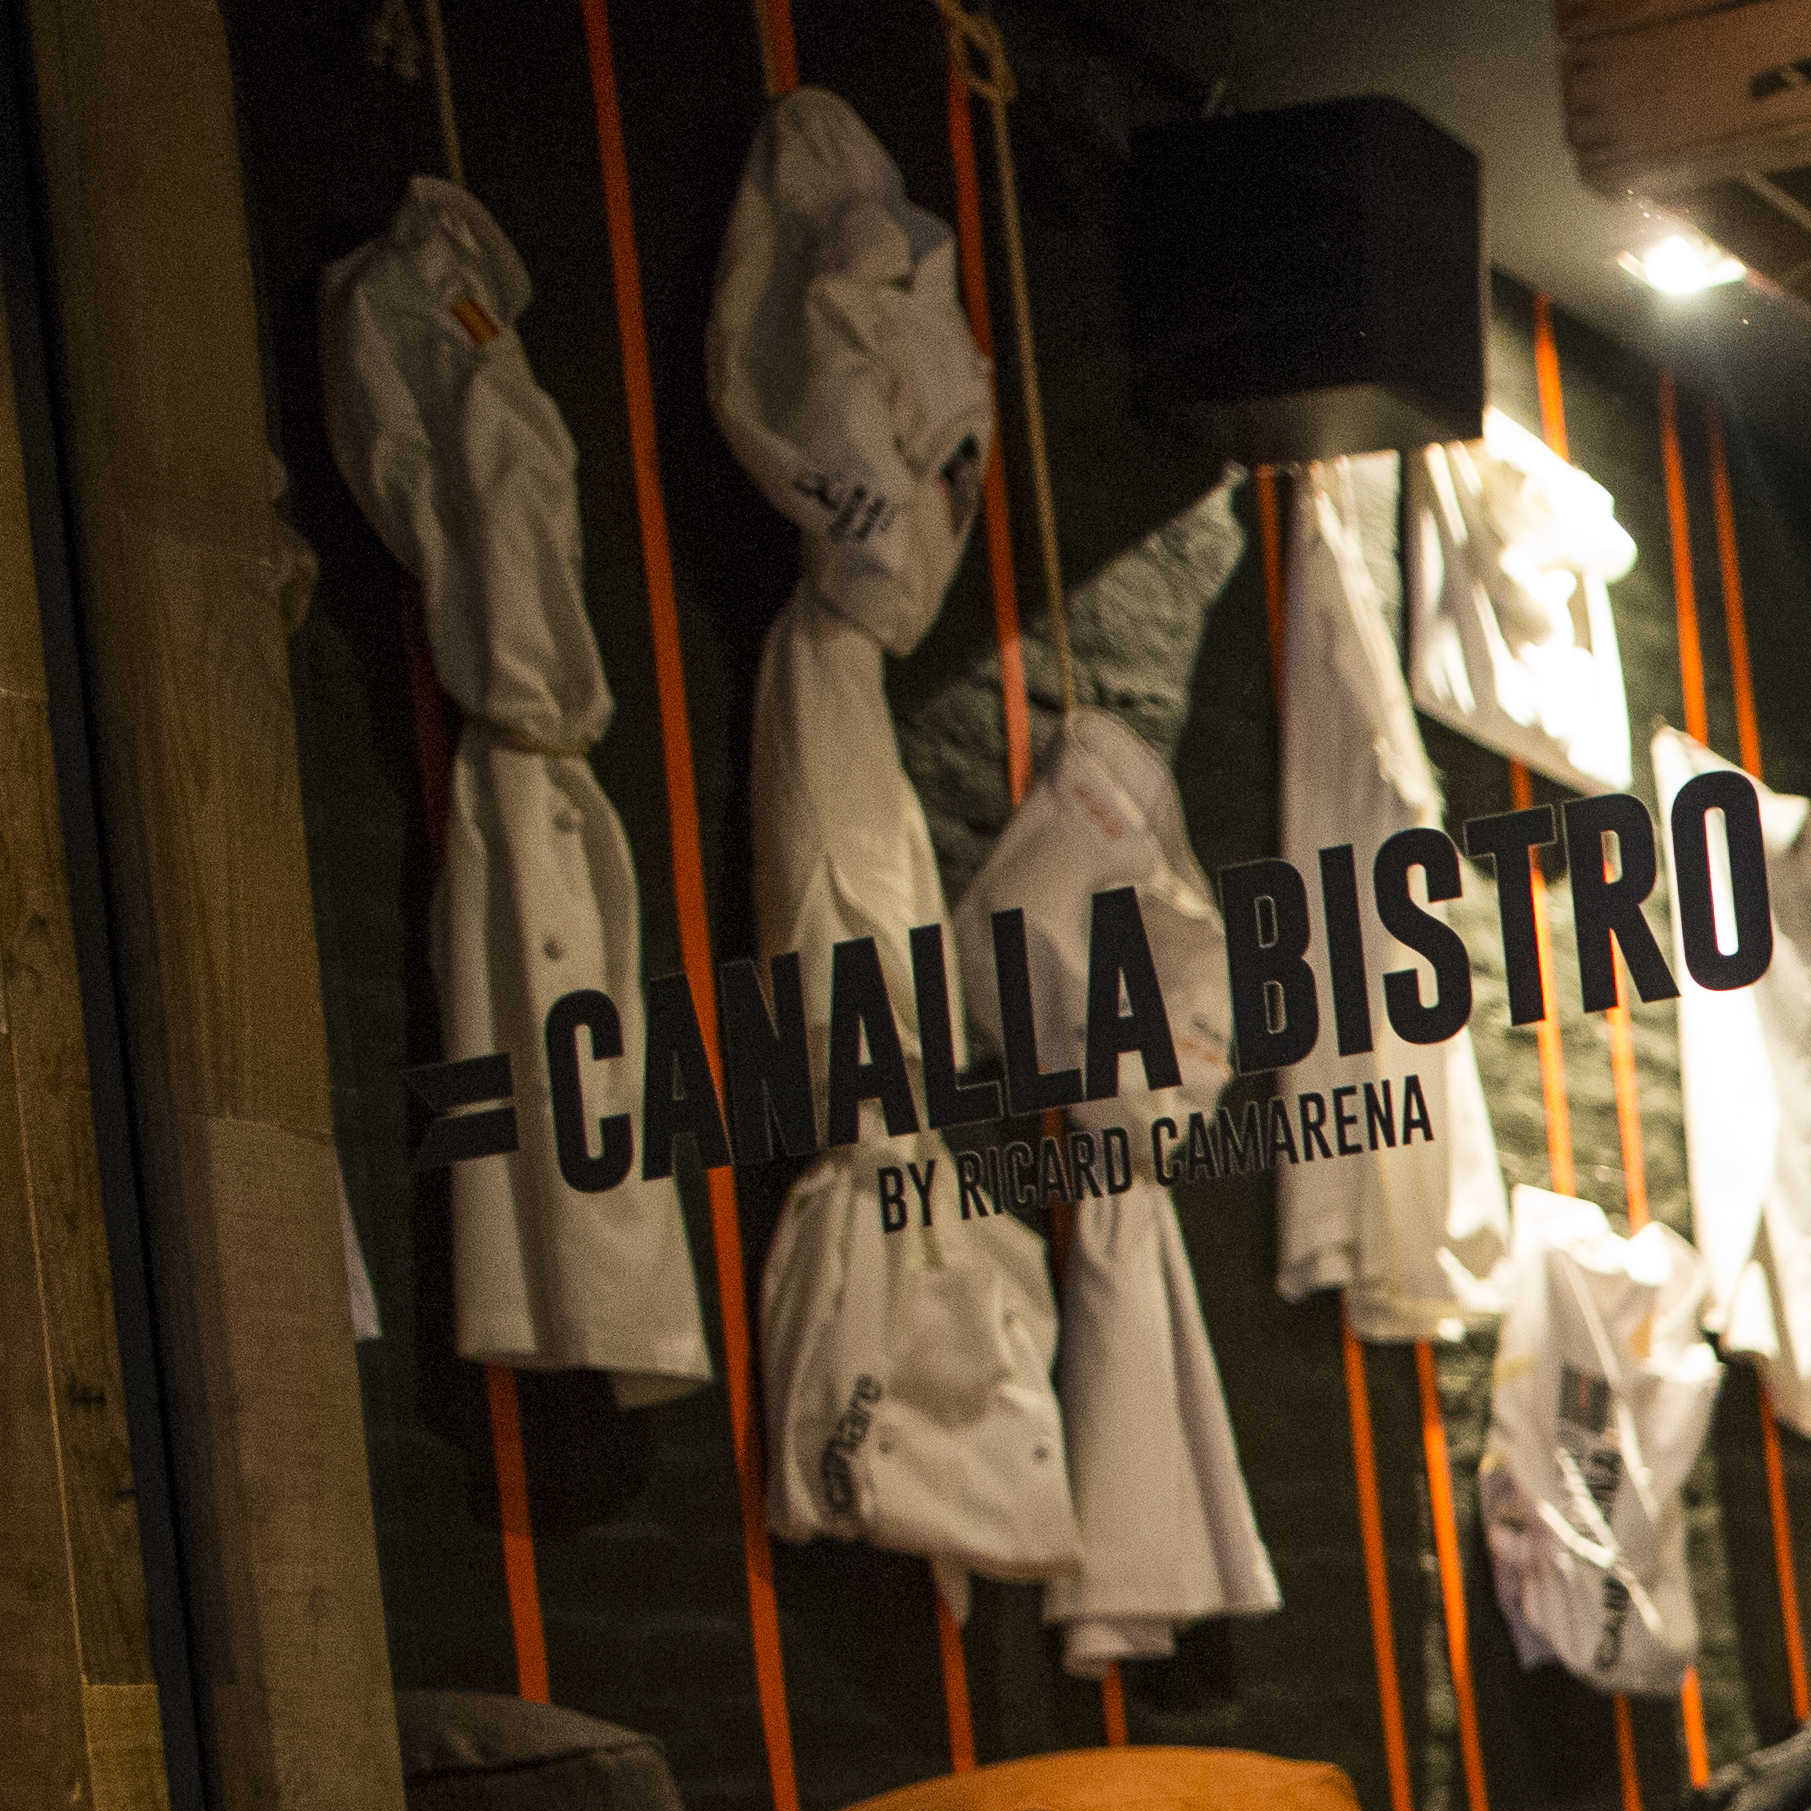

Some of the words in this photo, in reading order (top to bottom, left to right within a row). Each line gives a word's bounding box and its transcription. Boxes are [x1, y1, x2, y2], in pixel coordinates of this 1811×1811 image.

[545, 886, 1183, 1193] CANALLA
[1218, 770, 1774, 1075] BISTRO
[878, 1160, 936, 1233] BY
[957, 1126, 1132, 1221] RICARD
[1151, 1075, 1435, 1187] CAMARENA
